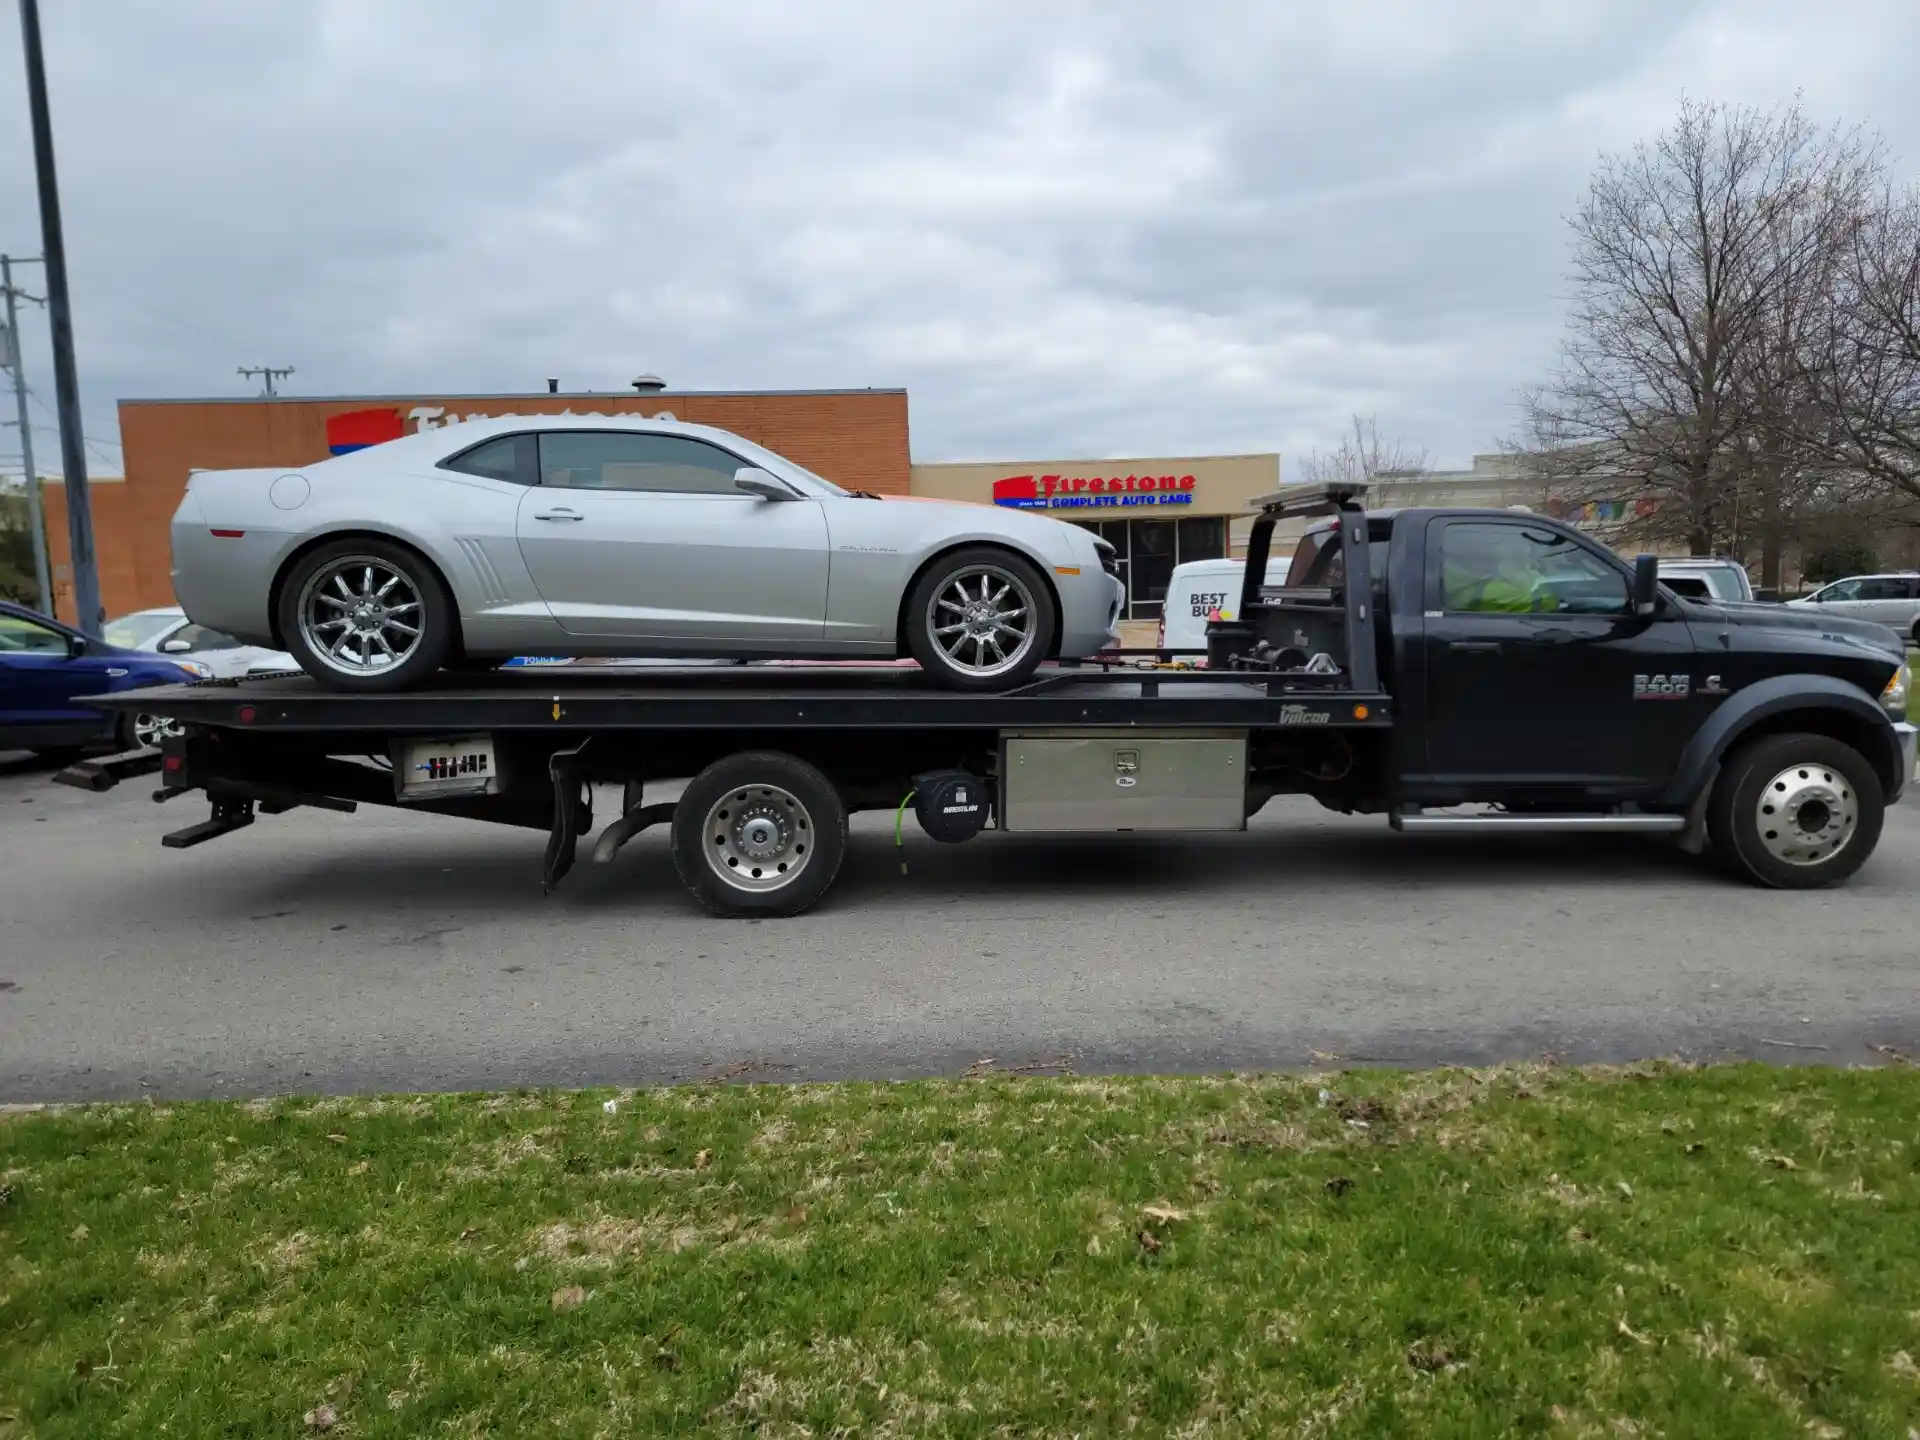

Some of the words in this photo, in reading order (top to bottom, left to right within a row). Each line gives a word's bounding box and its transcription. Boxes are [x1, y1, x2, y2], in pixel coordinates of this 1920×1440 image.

[1040, 474, 1196, 497] Firestone
[1052, 496, 1118, 508] COMPLETE
[1121, 495, 1155, 505] AUTO
[1159, 494, 1193, 505] CARE
[1190, 592, 1228, 605] BEST
[1634, 674, 1690, 685] RAM
[943, 804, 979, 814] MERLIN
